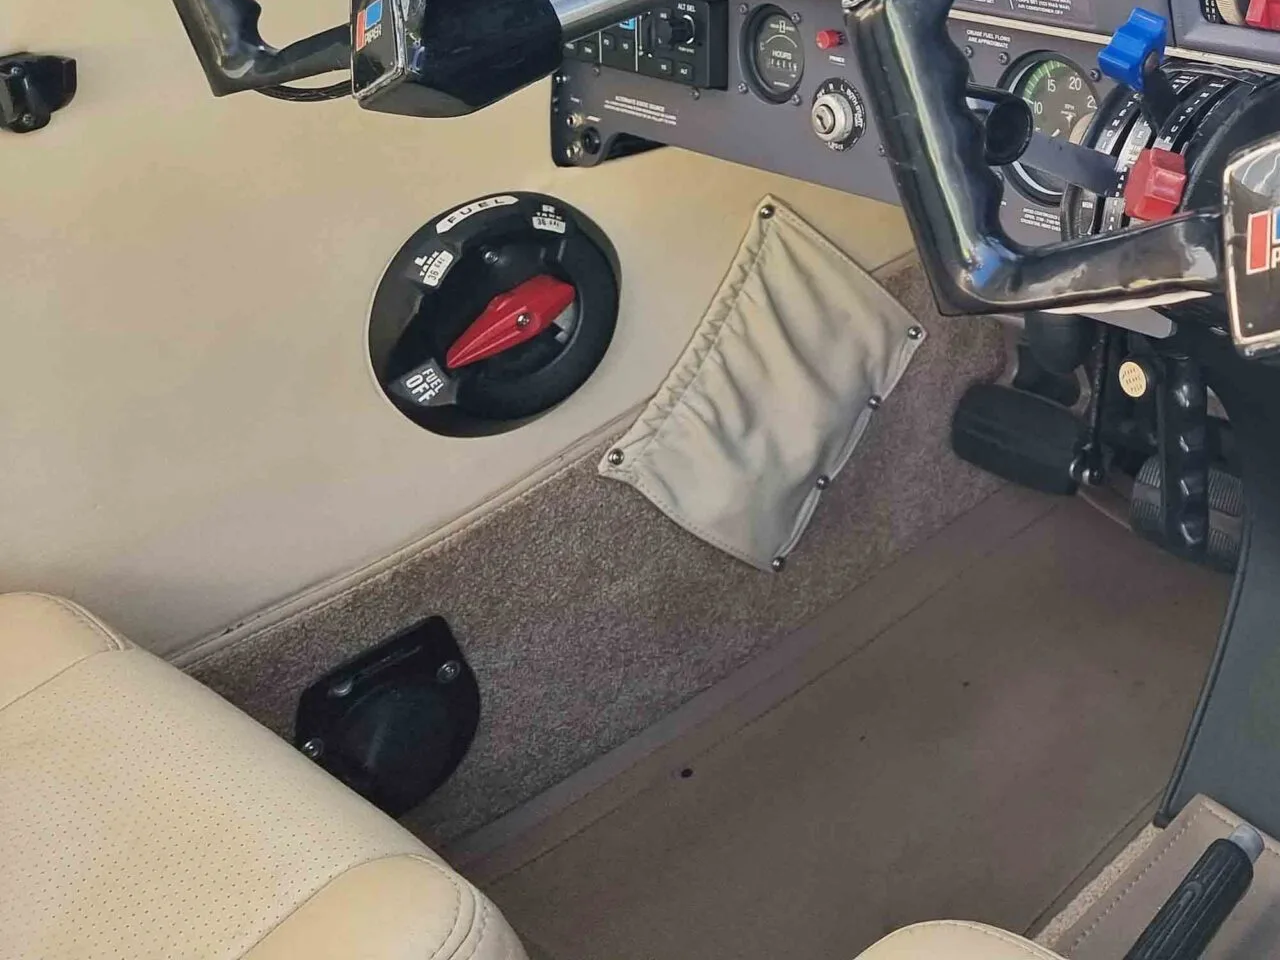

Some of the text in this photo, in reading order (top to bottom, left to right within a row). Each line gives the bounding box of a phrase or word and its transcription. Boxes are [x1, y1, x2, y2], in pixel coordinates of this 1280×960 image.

[1047, 79, 1056, 92] 15
[1069, 77, 1082, 90] 20
[405, 374, 436, 403] OFF
[422, 368, 444, 394] FUEL
